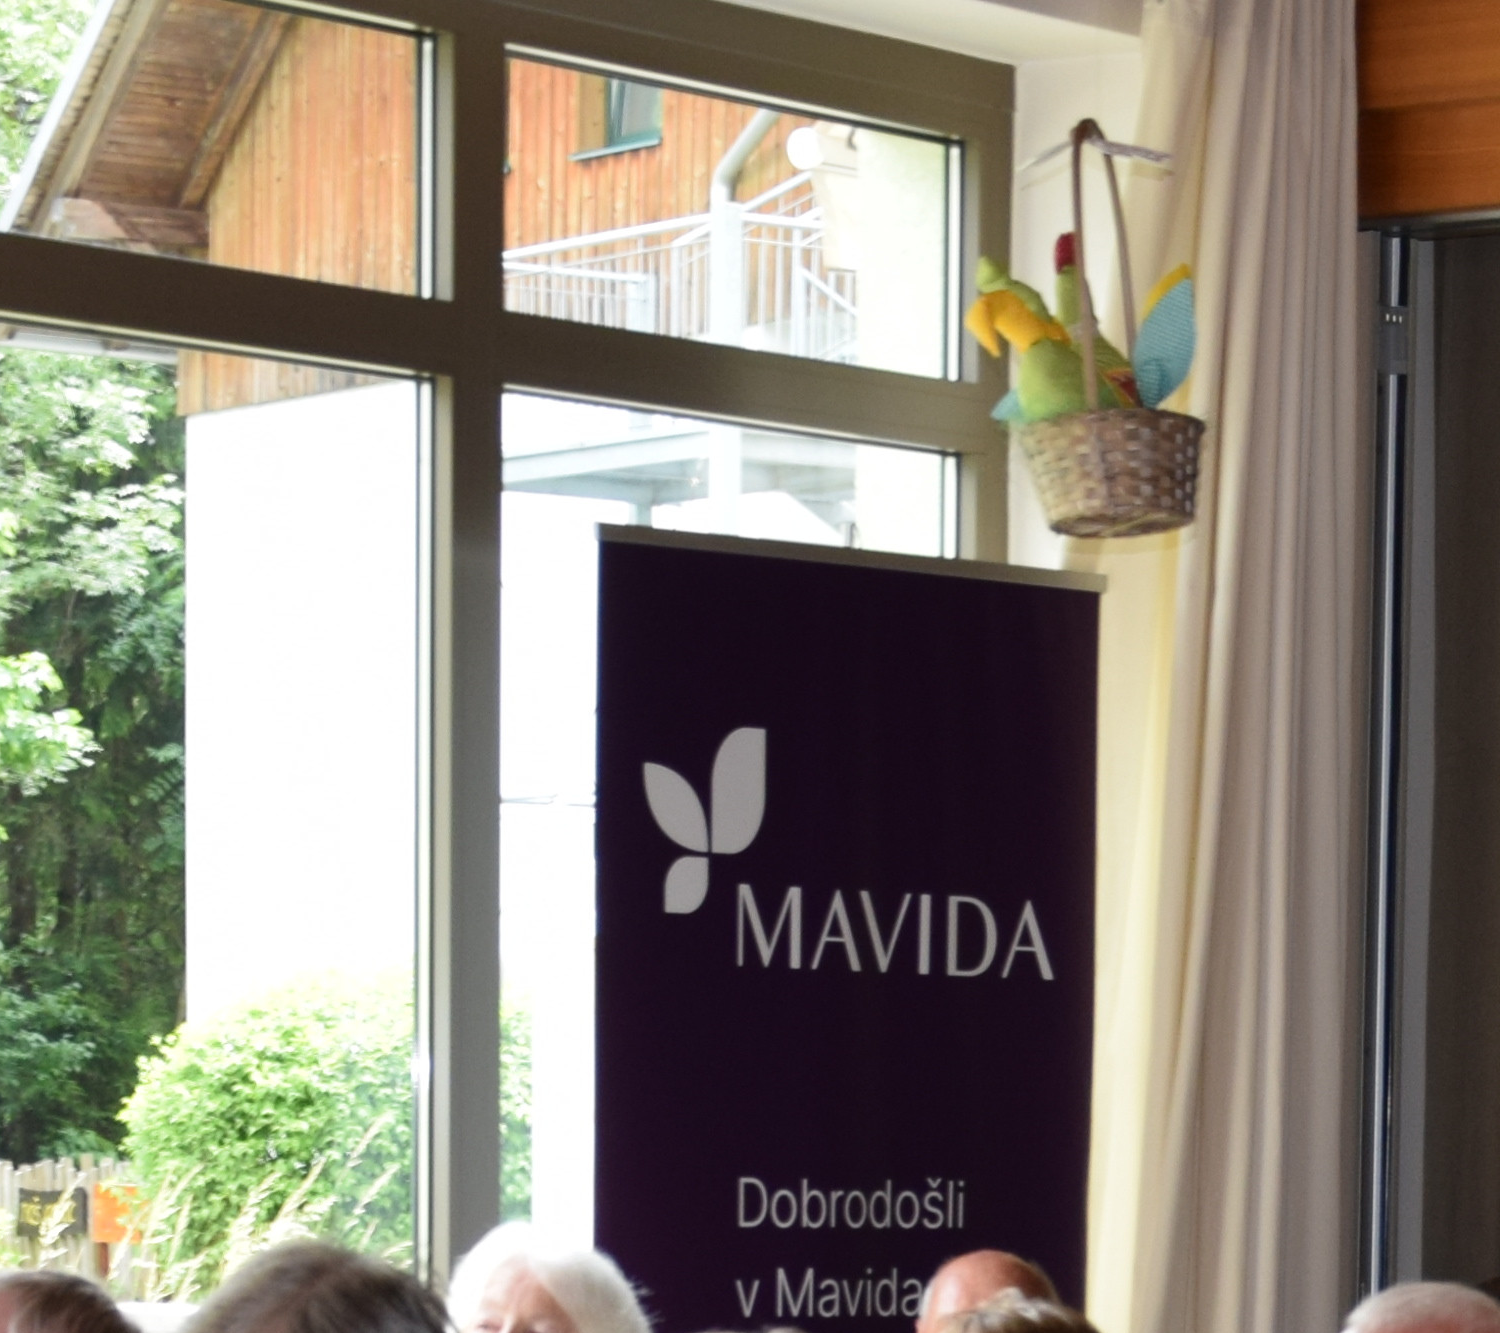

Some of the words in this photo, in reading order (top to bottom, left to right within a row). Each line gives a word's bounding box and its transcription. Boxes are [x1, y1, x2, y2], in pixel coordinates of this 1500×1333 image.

[736, 882, 1055, 981] MAVIDA
[737, 1175, 966, 1230] Dobrodošli
[735, 1279, 761, 1318] v
[775, 1266, 924, 1318] Mavida
